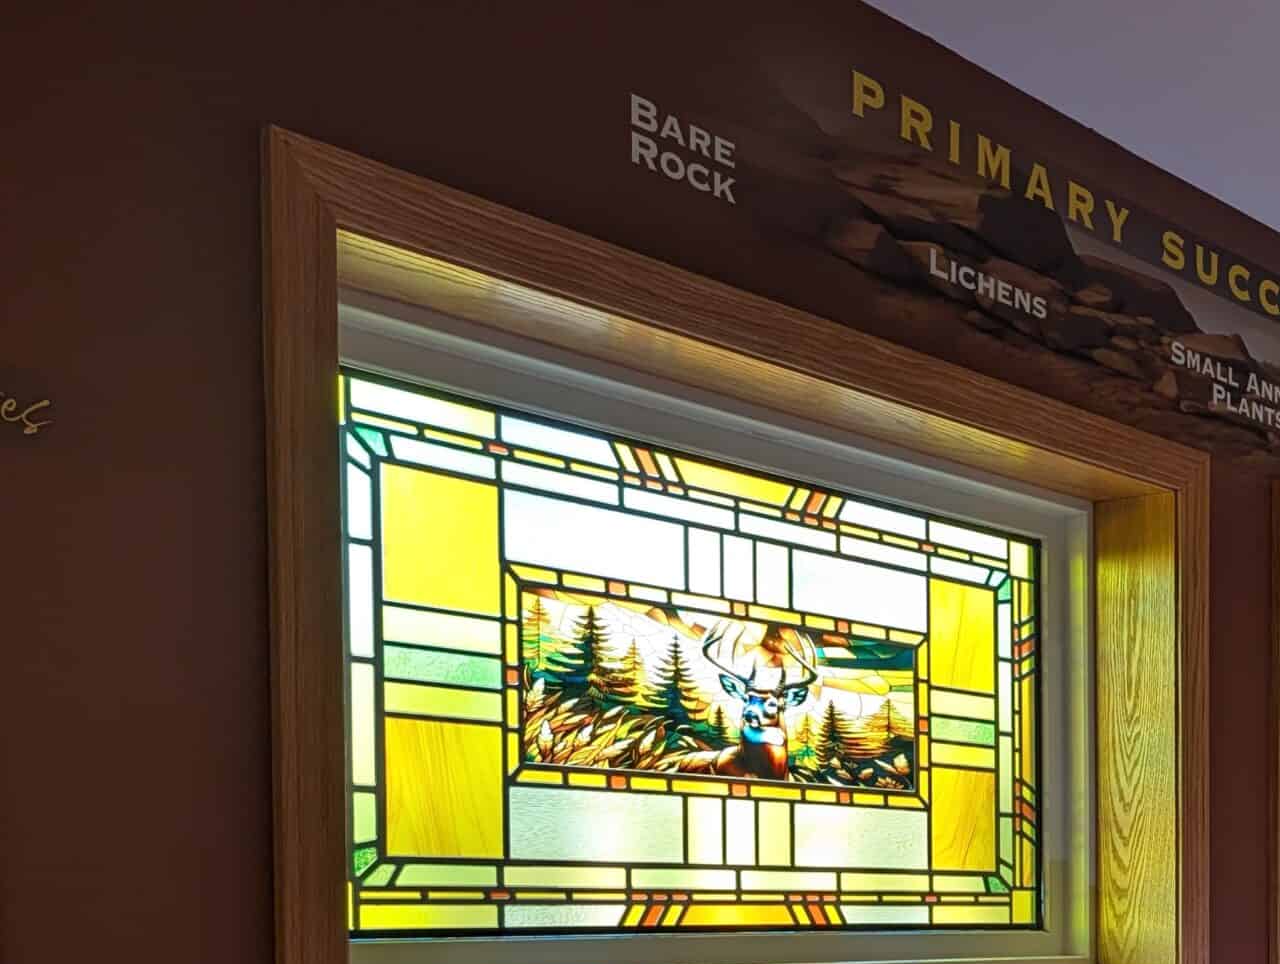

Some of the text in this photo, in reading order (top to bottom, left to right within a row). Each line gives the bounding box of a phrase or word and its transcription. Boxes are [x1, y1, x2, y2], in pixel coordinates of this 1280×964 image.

[630, 94, 736, 168] BARE
[630, 131, 736, 204] ROCK
[852, 70, 1130, 242] PRIMARY
[929, 248, 1048, 320] LICHENS
[1171, 341, 1240, 388] SMALL
